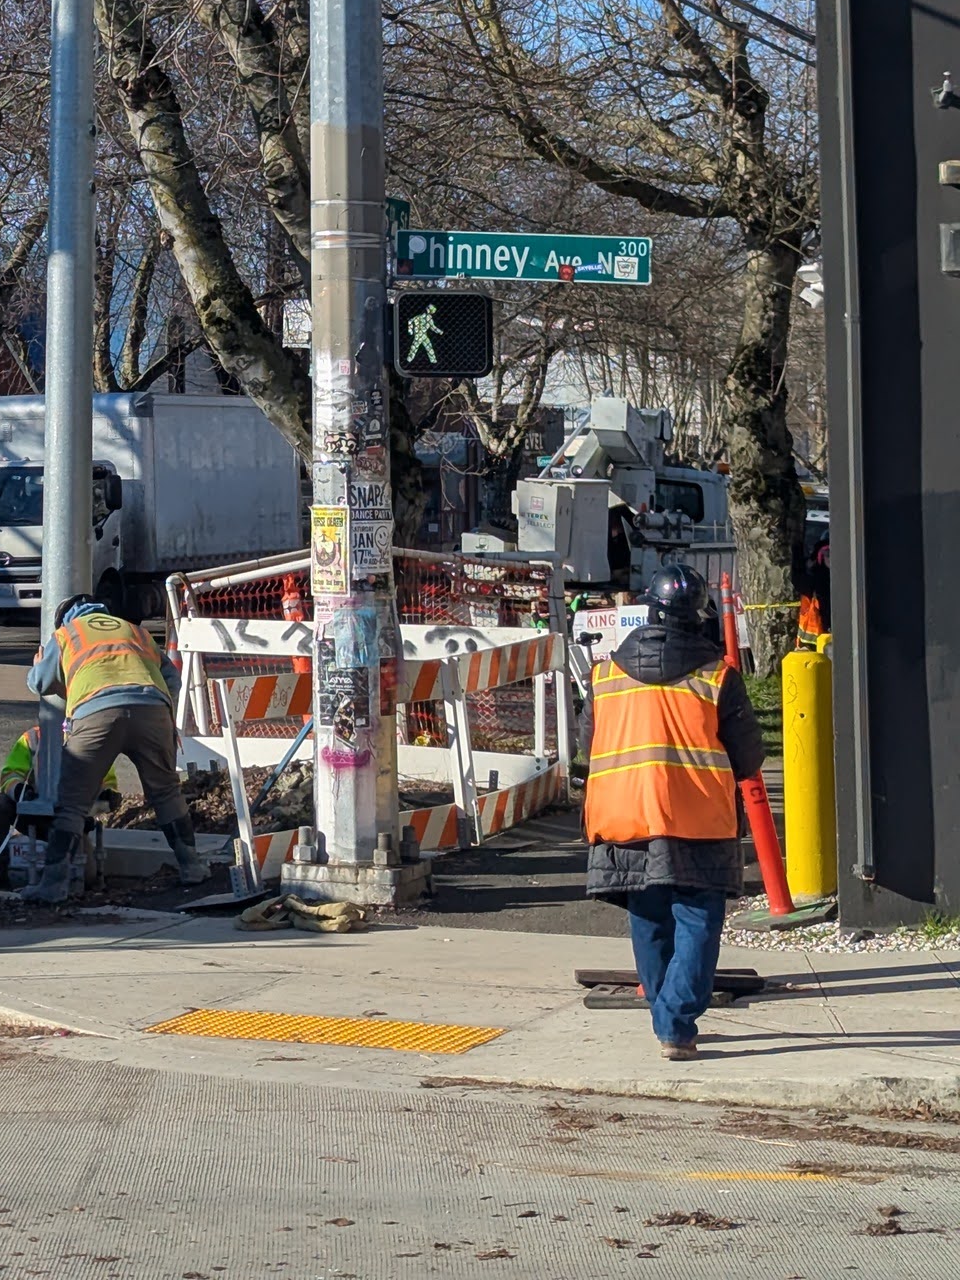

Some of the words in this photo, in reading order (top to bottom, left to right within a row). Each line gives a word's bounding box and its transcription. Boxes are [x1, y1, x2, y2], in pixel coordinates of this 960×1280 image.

[408, 235, 530, 277] Phinney
[598, 251, 612, 275] N
[618, 241, 647, 256] 300
[349, 484, 384, 508] SNAP!
[374, 510, 392, 520] PARTY
[351, 525, 374, 533] SATURDAY
[352, 532, 374, 549] JAN
